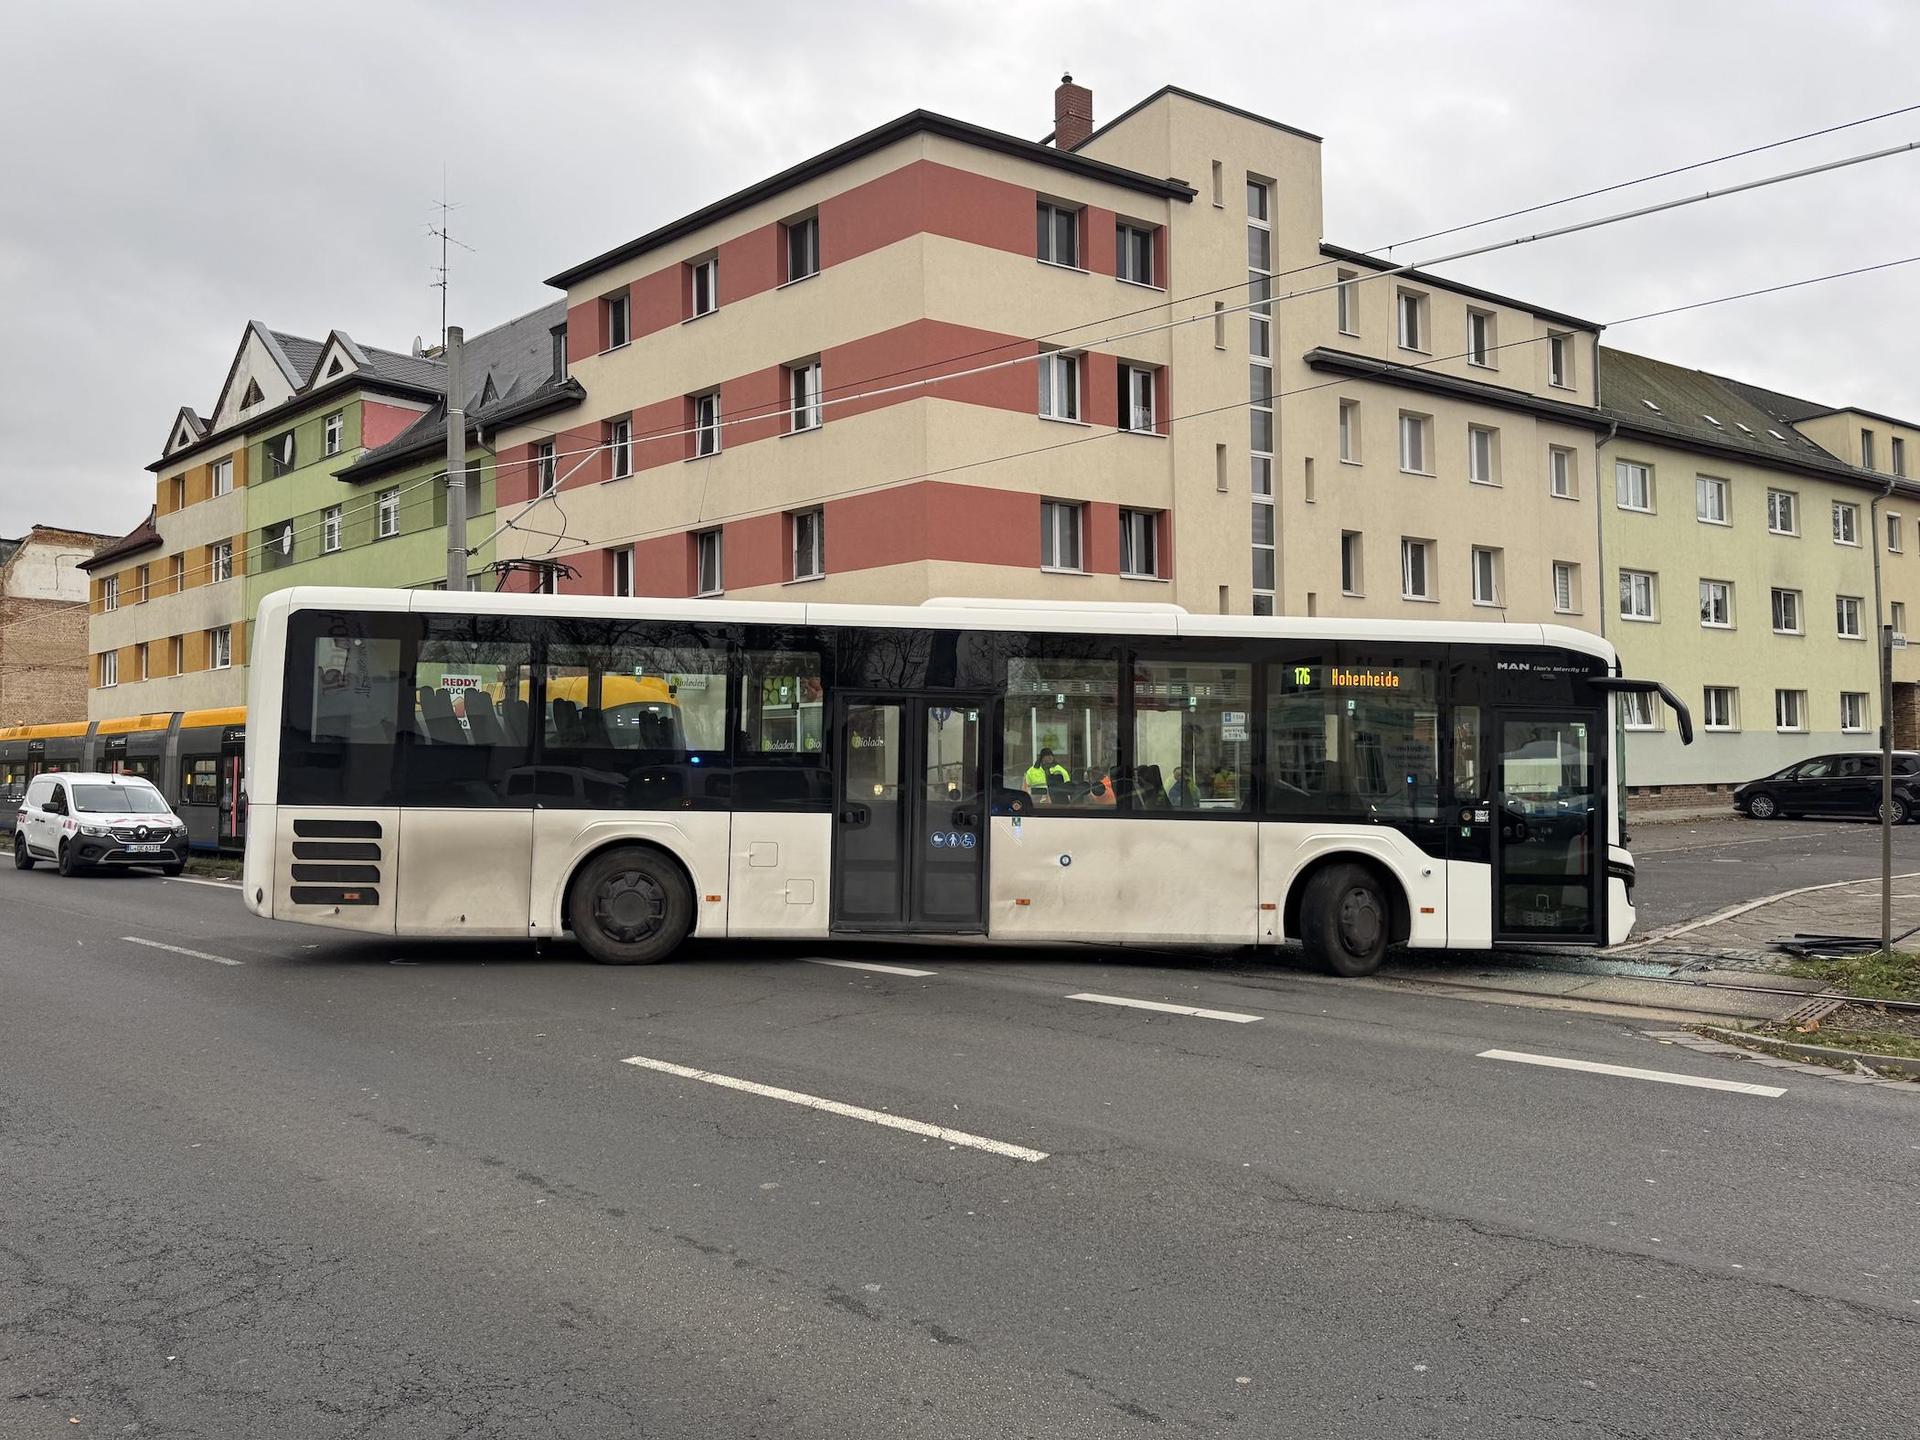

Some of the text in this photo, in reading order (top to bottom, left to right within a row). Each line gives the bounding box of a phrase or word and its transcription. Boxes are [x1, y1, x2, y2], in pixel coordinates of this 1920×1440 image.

[1497, 662, 1530, 671] MAN
[1553, 665, 1580, 674] Intercity
[442, 677, 478, 687] REDDY
[1294, 667, 1400, 687] 176 Hohenheida
[765, 740, 795, 751] Bioladen
